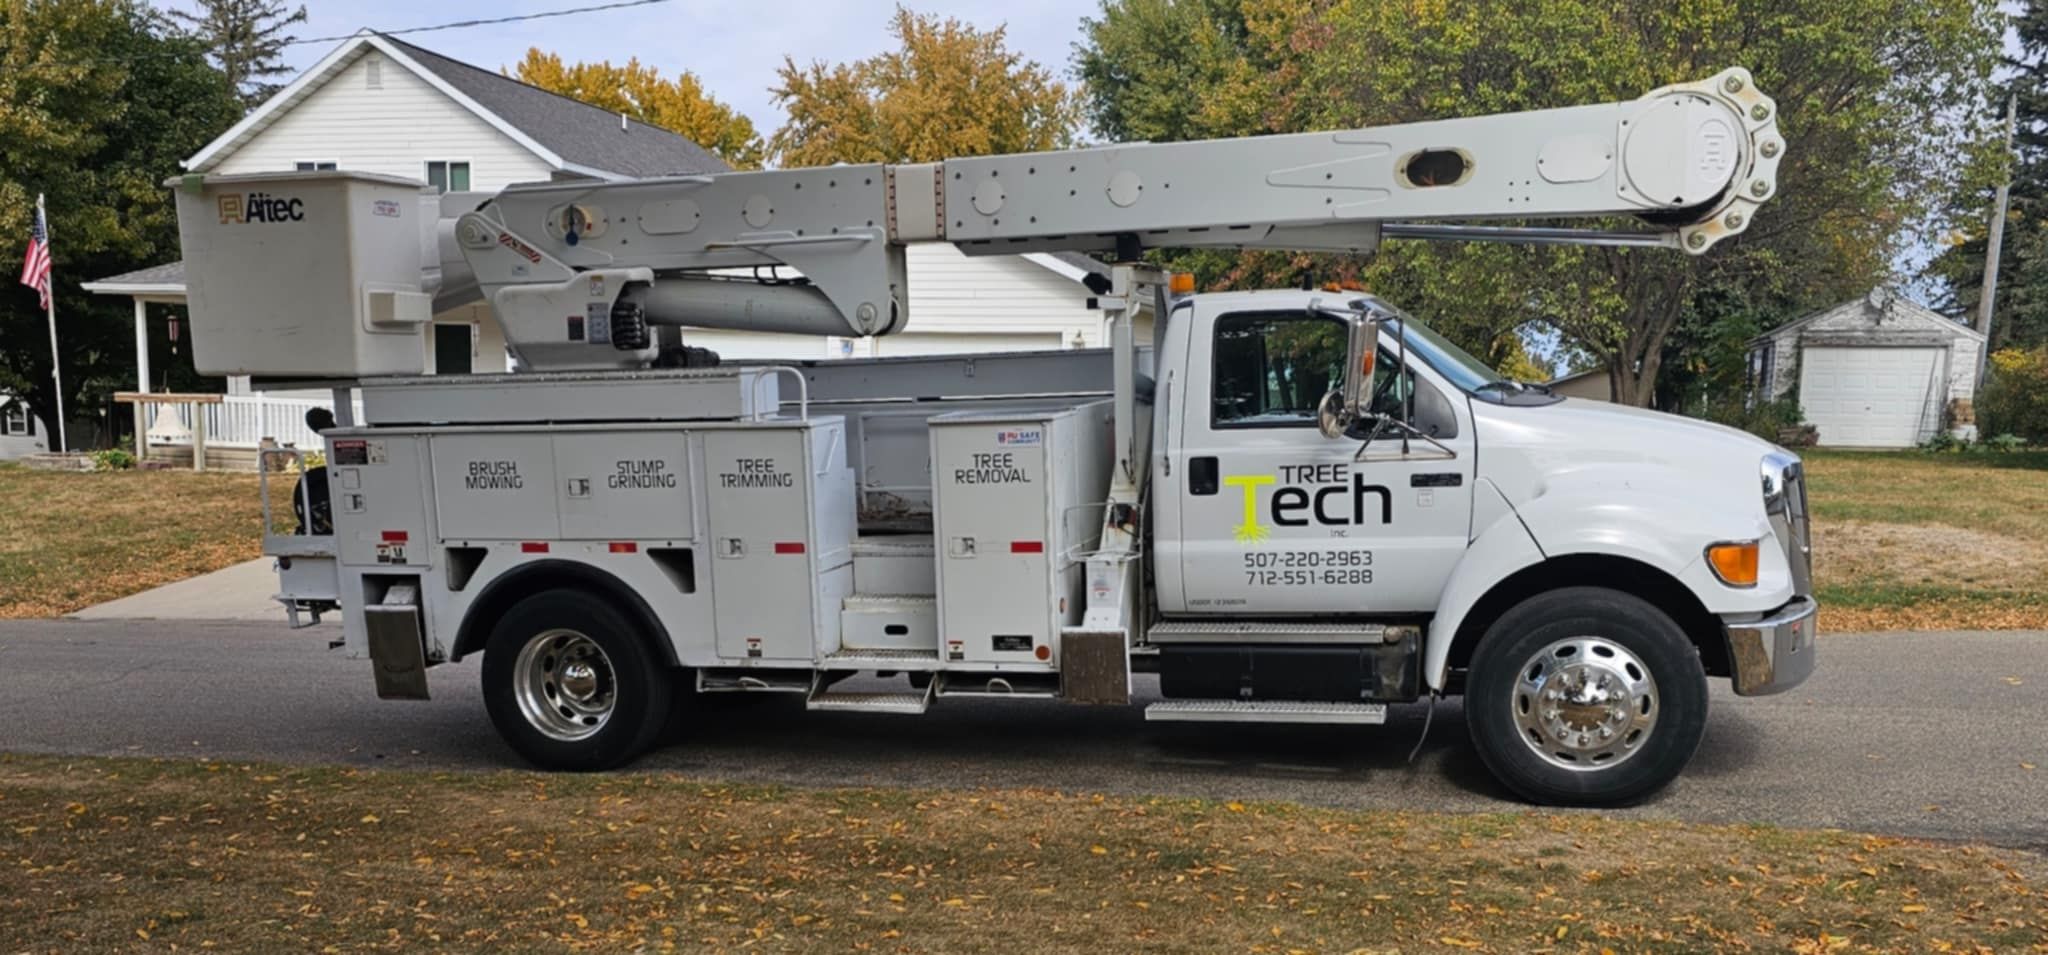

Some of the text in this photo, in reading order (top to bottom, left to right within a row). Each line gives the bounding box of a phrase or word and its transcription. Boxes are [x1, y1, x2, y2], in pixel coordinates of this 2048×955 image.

[245, 192, 304, 223] Altec
[616, 460, 665, 475] STUMP
[737, 459, 774, 473] TREE
[972, 453, 1013, 468] TREE
[468, 461, 518, 476] BRUSH
[1279, 463, 1349, 484] TREE
[465, 475, 523, 489] MOWING
[608, 474, 676, 489] GRINDING
[720, 473, 793, 488] TRIMMING
[955, 469, 1031, 484] REMOVAL
[1223, 472, 1392, 541] Tech
[1244, 551, 1373, 568] 507-220-2963
[1245, 569, 1373, 585] 712-551-6288
